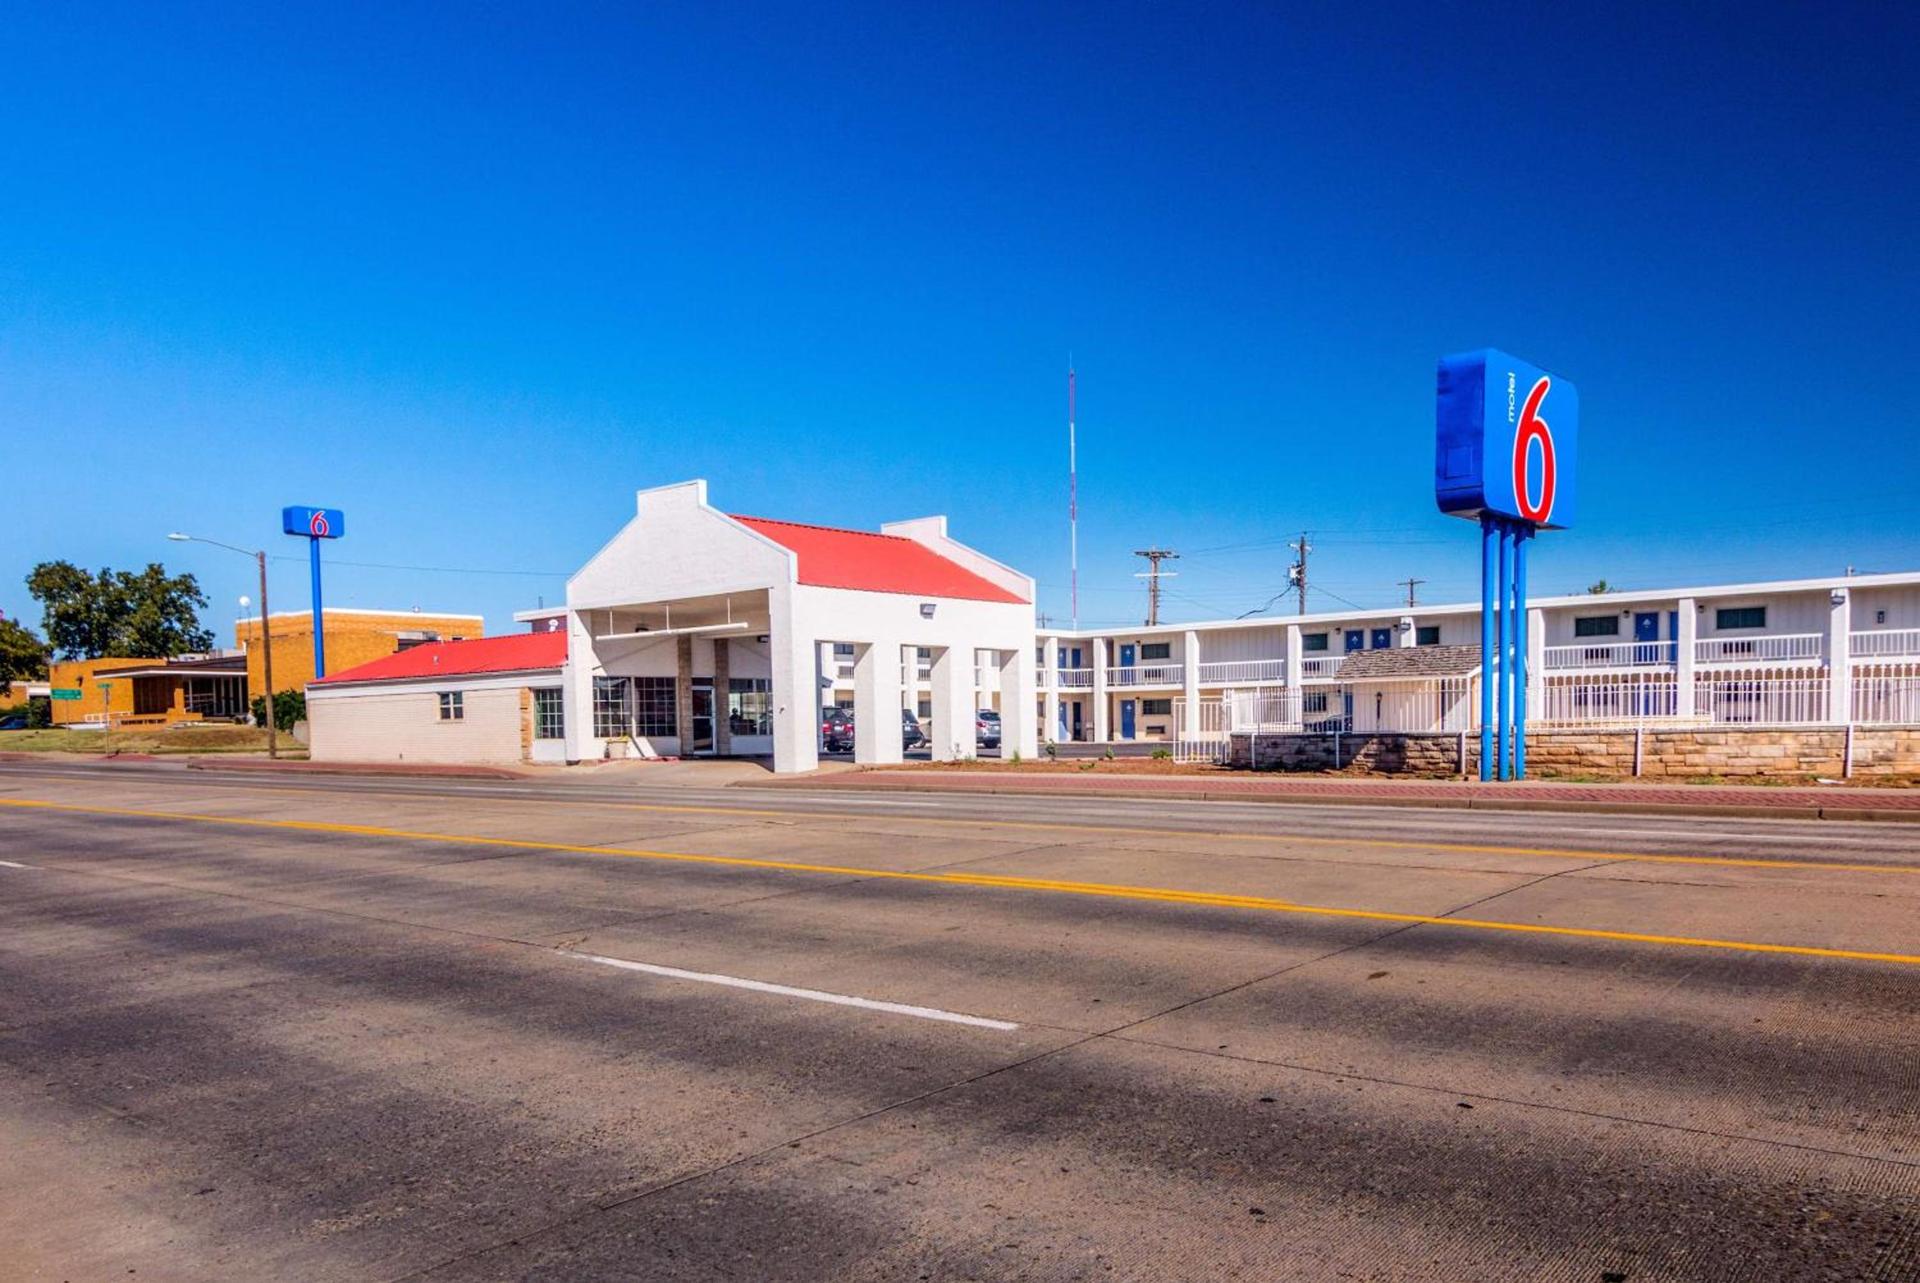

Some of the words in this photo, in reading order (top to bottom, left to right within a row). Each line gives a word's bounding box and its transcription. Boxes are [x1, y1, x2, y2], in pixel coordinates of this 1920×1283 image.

[1508, 372, 1516, 422] motel
[1512, 375, 1556, 523] 6
[310, 511, 329, 537] 6
